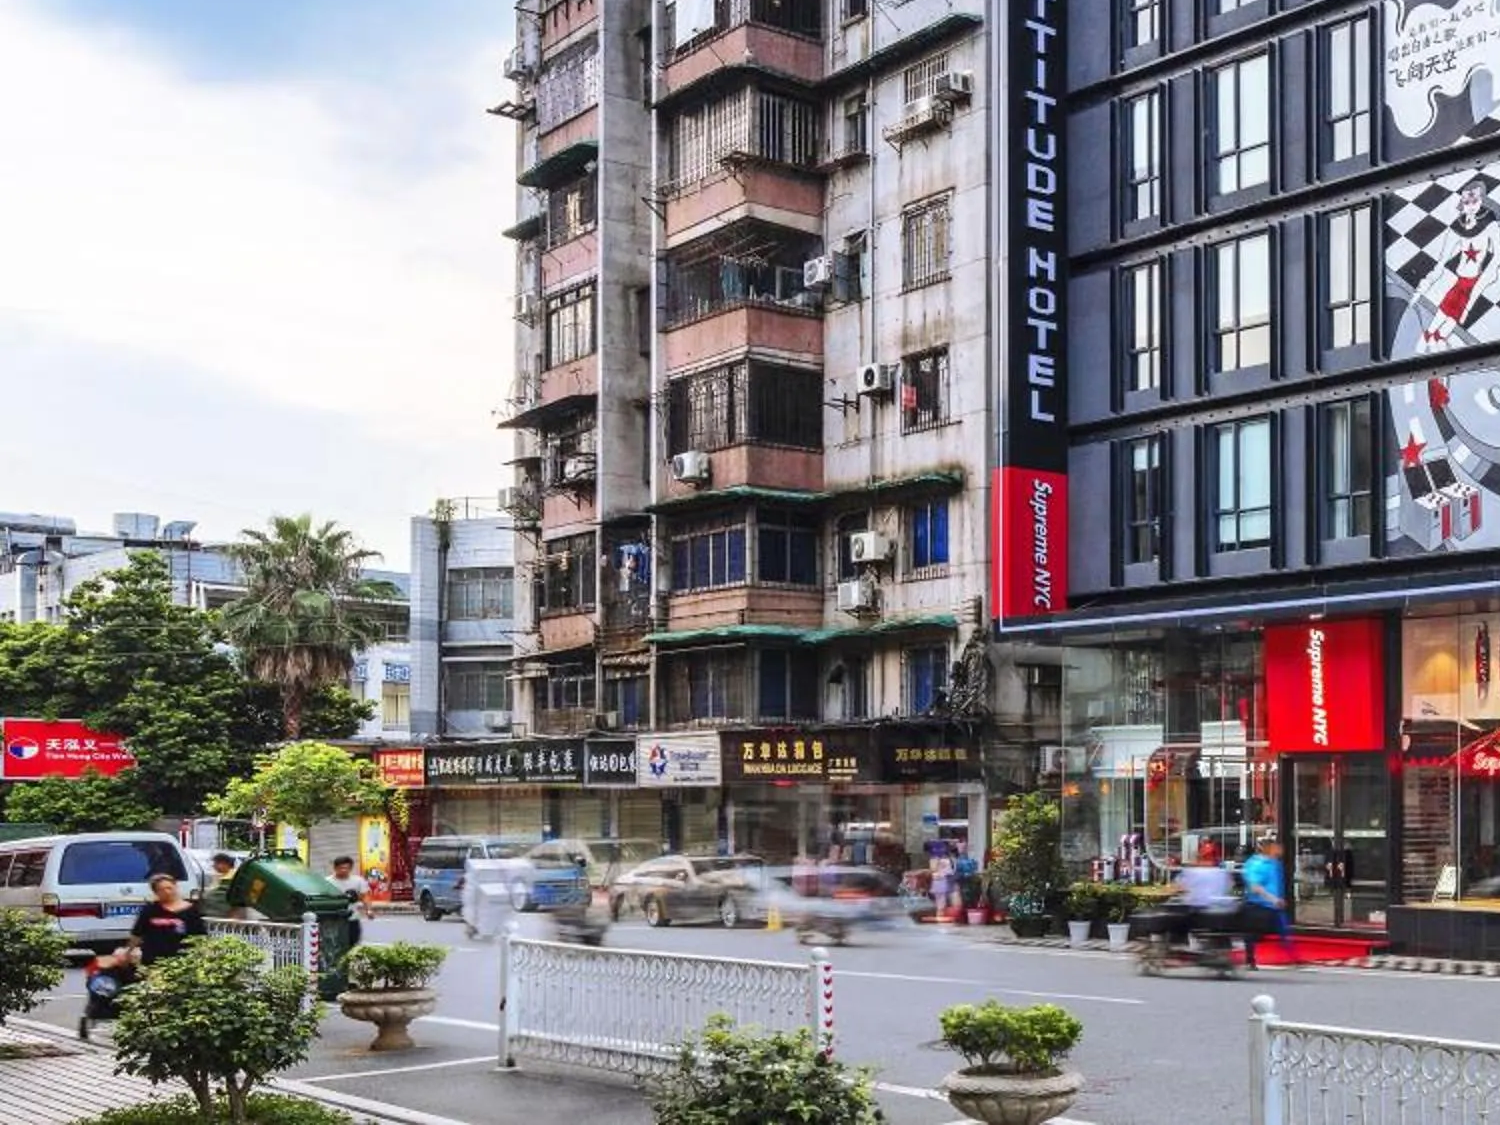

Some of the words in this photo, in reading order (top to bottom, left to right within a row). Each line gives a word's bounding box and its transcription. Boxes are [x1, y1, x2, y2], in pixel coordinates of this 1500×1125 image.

[1026, 246, 1058, 424] HOTEL
[1029, 478, 1053, 567] Supreme
[1034, 569, 1052, 610] NYC
[1306, 628, 1326, 706] Supreme
[1311, 706, 1329, 746] NYC
